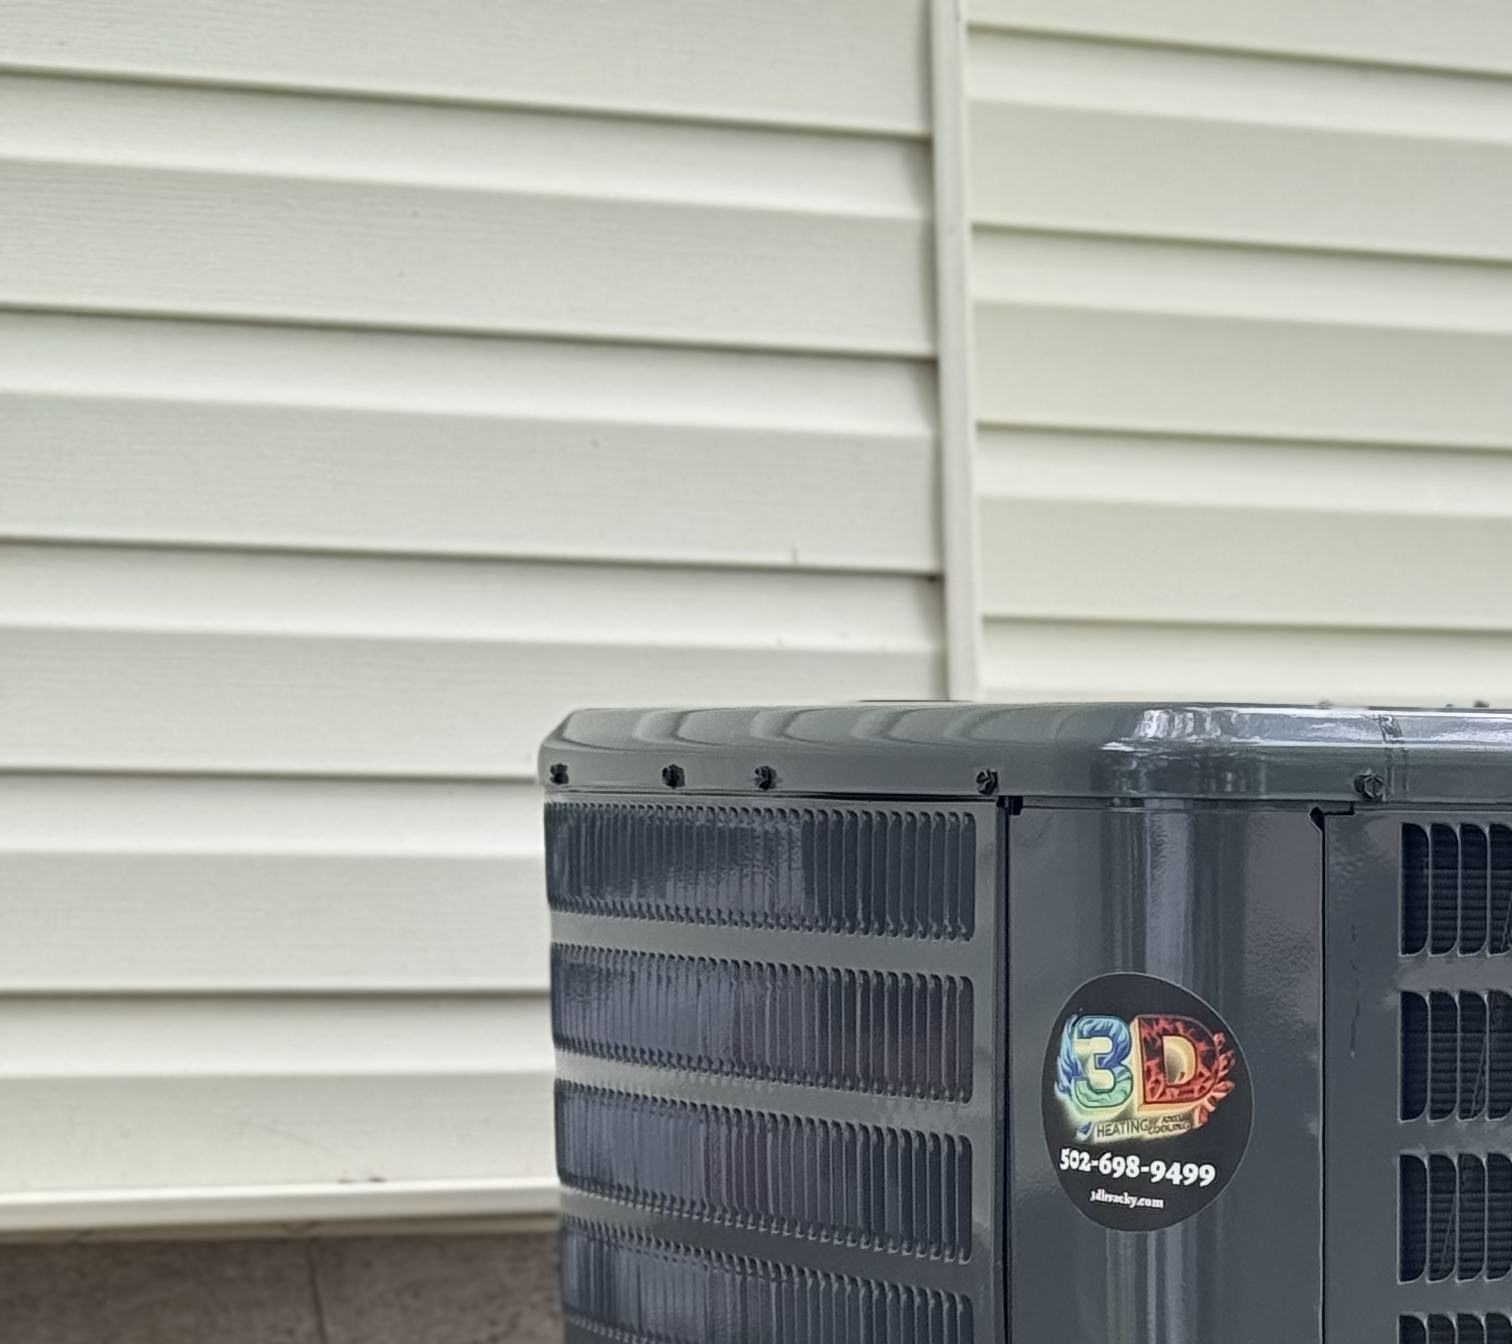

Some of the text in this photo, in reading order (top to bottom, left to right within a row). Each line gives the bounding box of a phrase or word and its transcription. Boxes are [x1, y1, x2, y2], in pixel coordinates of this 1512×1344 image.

[1058, 1013, 1230, 1111] 3D
[1097, 1118, 1150, 1138] HEATING
[1059, 1148, 1217, 1187] 502-698-9499
